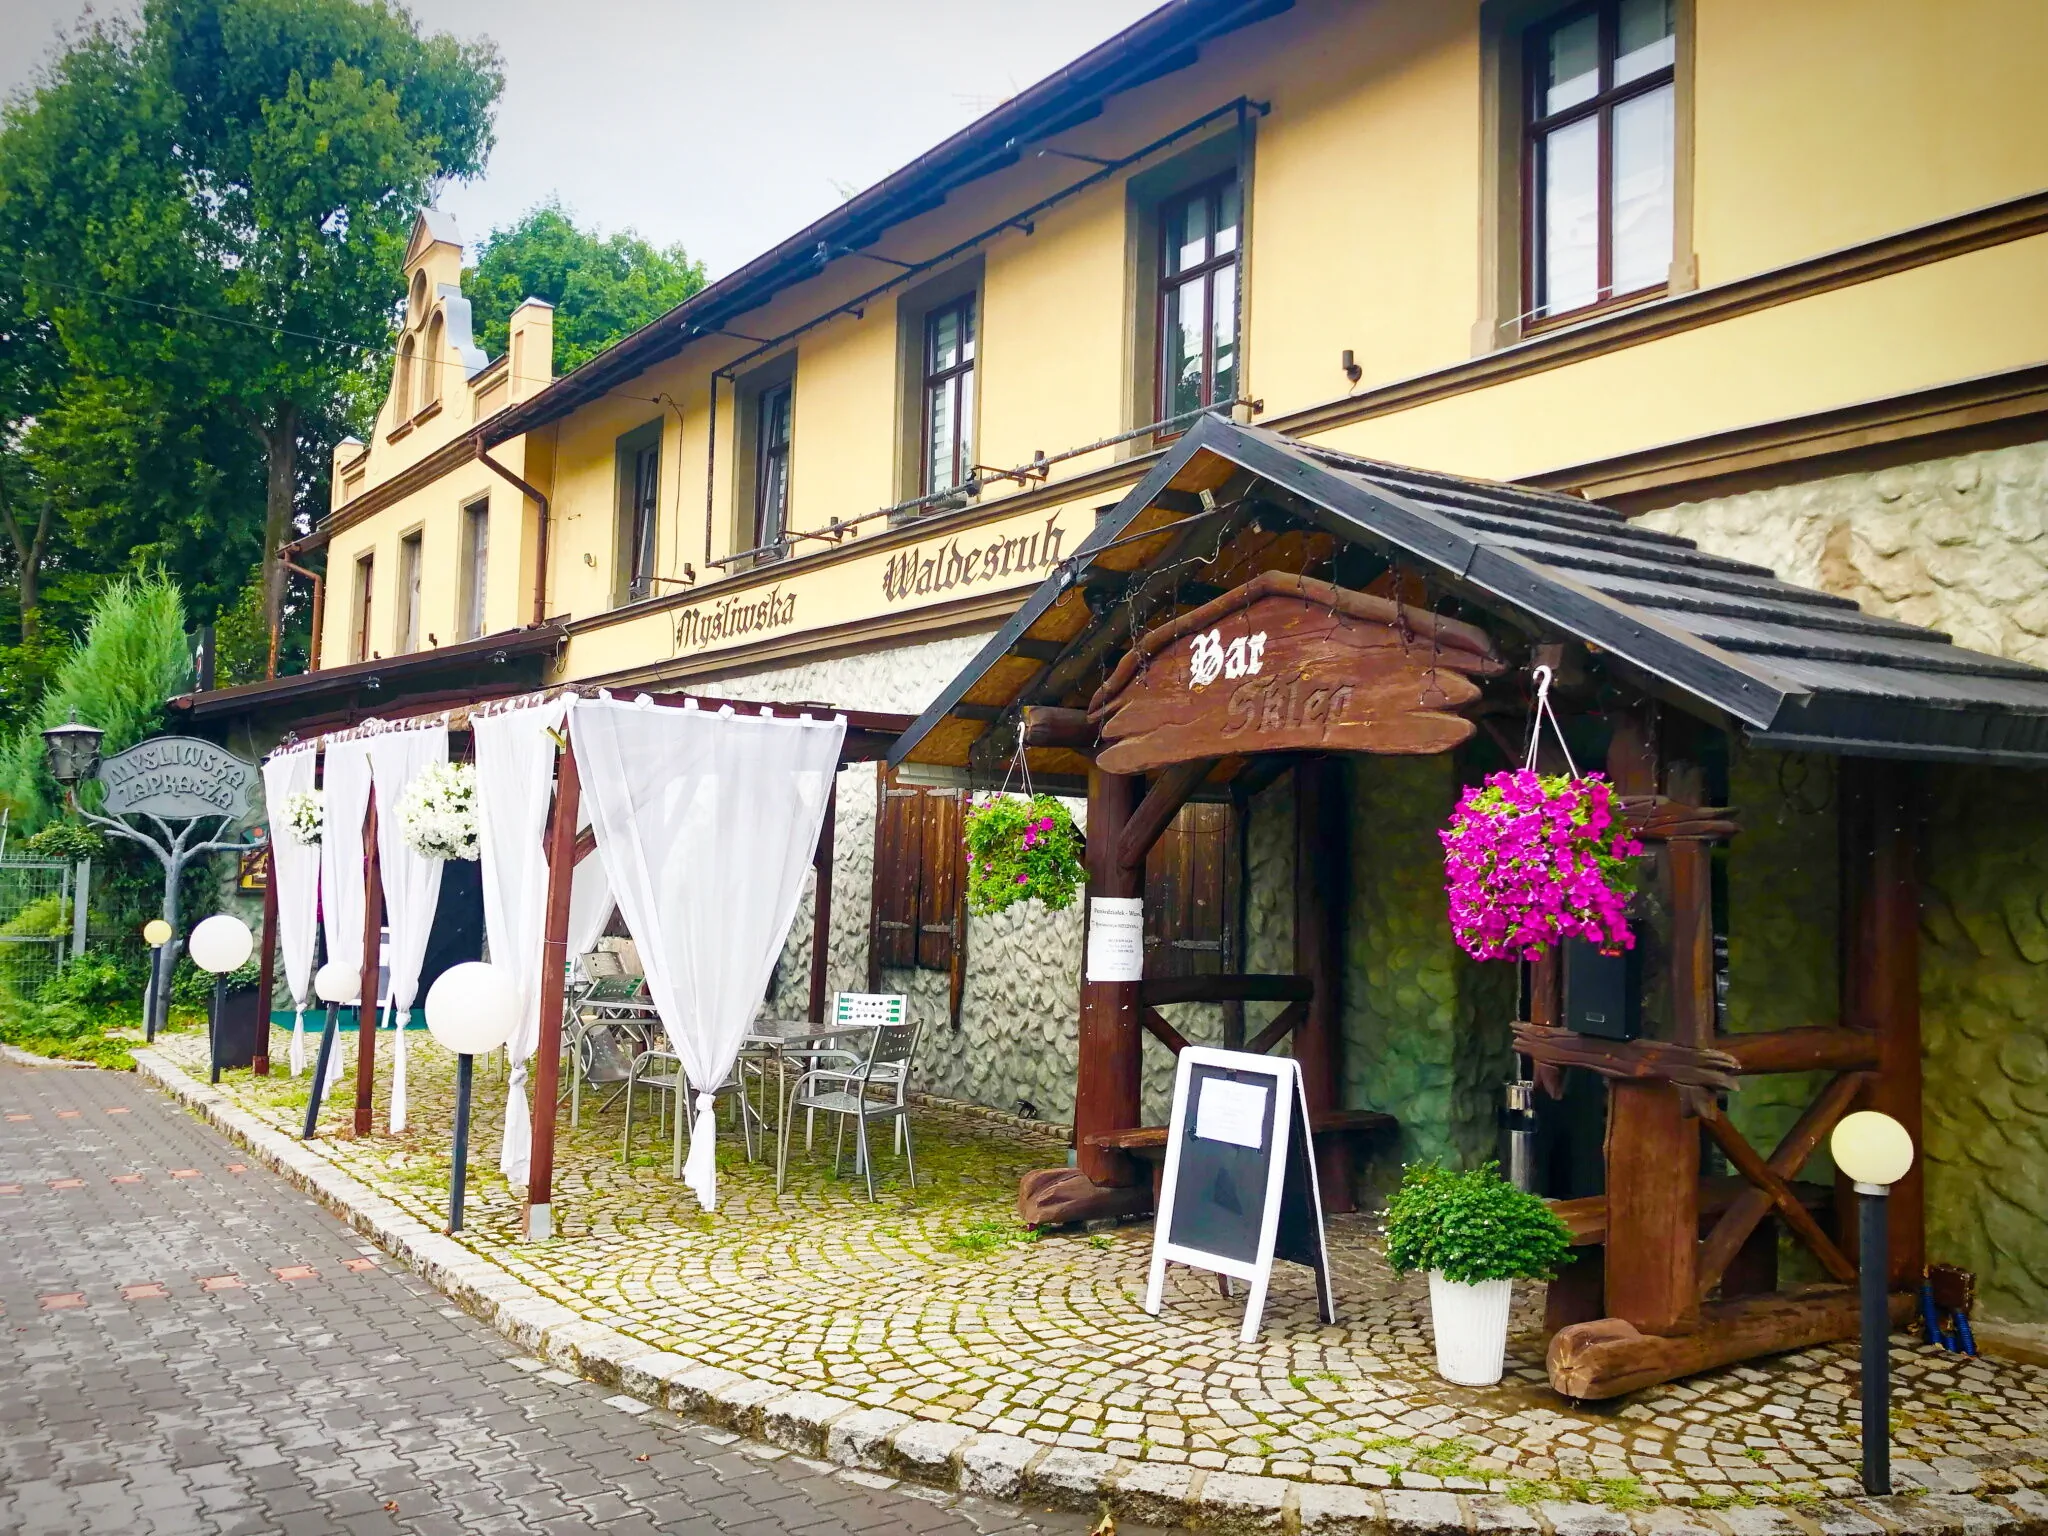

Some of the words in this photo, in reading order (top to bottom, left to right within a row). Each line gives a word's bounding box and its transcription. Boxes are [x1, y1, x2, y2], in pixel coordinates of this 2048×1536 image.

[883, 507, 1066, 602] Waldesruh
[677, 583, 797, 652] Myśliwska
[1189, 628, 1267, 690] Bar
[118, 774, 233, 810] ZAPRASZA
